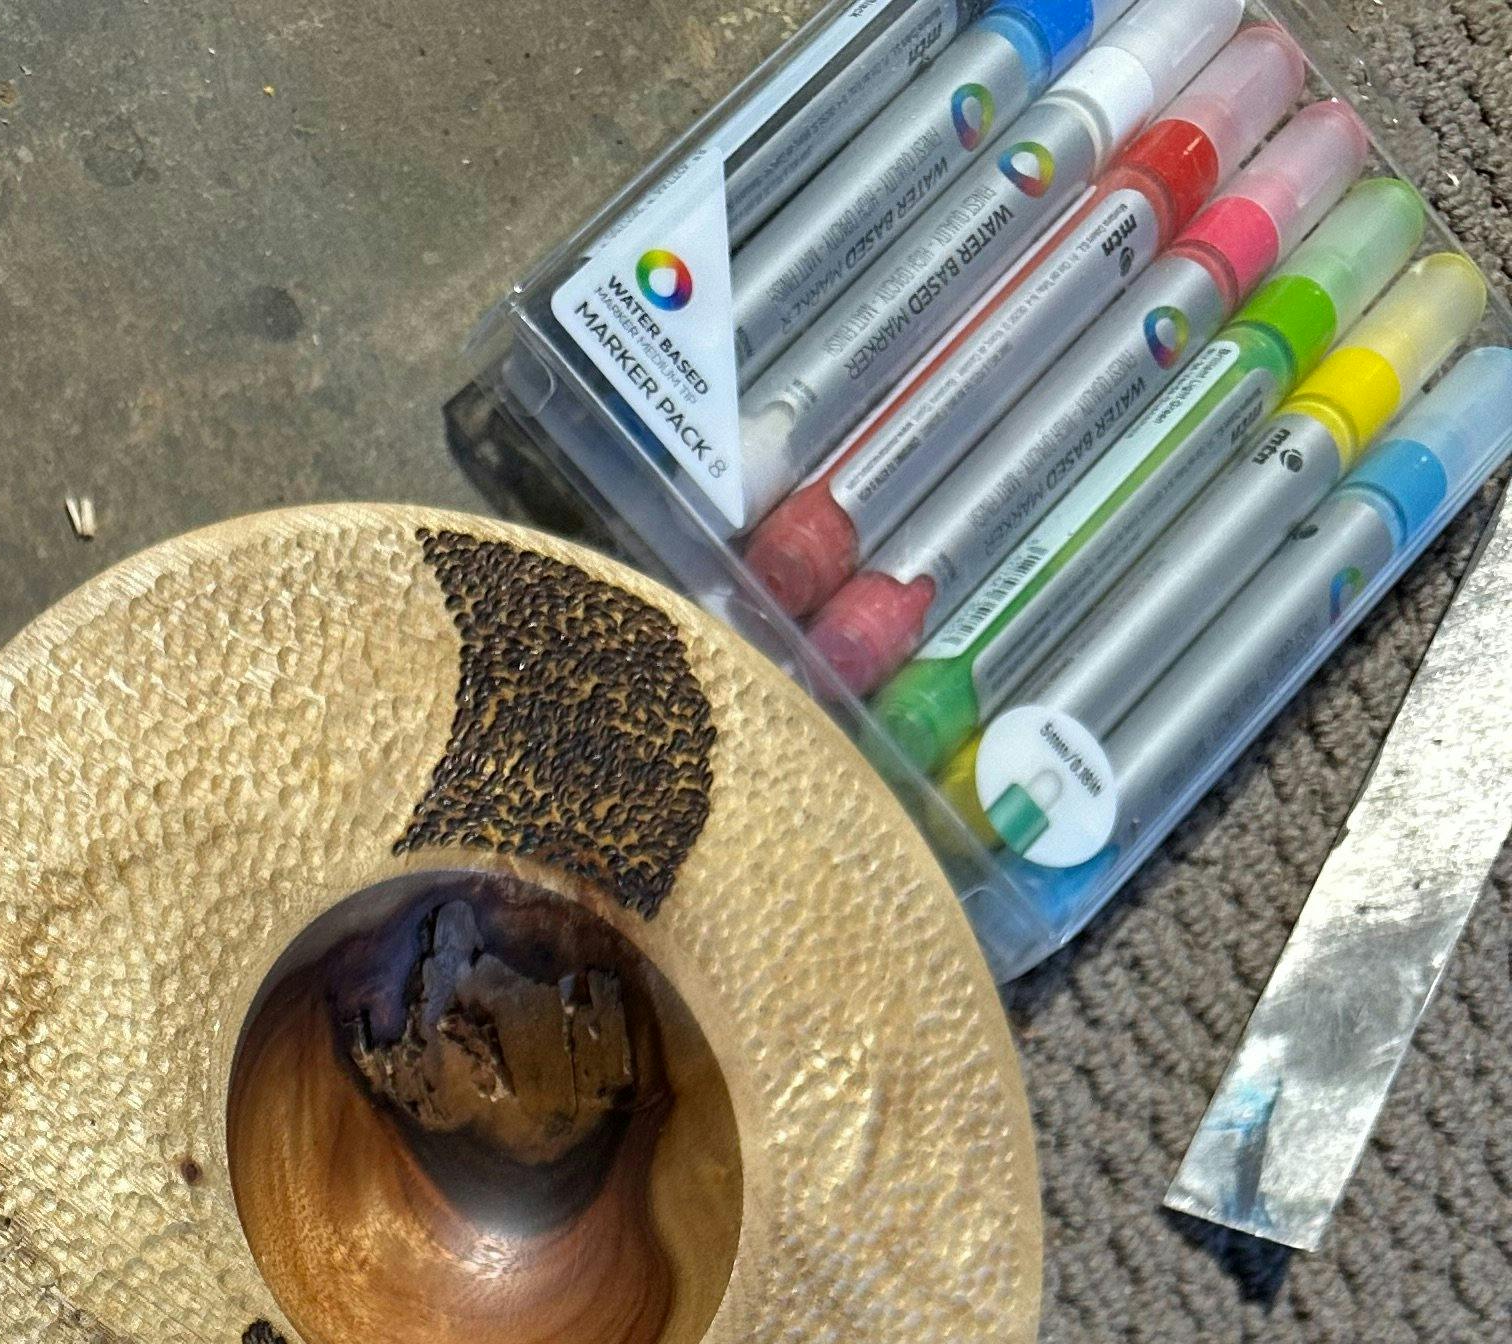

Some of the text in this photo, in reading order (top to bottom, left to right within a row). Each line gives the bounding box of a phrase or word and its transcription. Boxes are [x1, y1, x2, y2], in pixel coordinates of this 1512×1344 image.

[892, 158, 950, 216] WATER
[1101, 213, 1137, 257] mtn
[595, 286, 638, 339] MARKER
[843, 205, 1012, 378] WATER BASED MARKER
[607, 274, 661, 341] WATER
[659, 338, 708, 395] BASED
[575, 301, 659, 400] MARKER
[655, 397, 712, 462] PACK
[708, 459, 727, 479] 8
[1091, 377, 1147, 438] WATER
[1251, 428, 1291, 465] mtn
